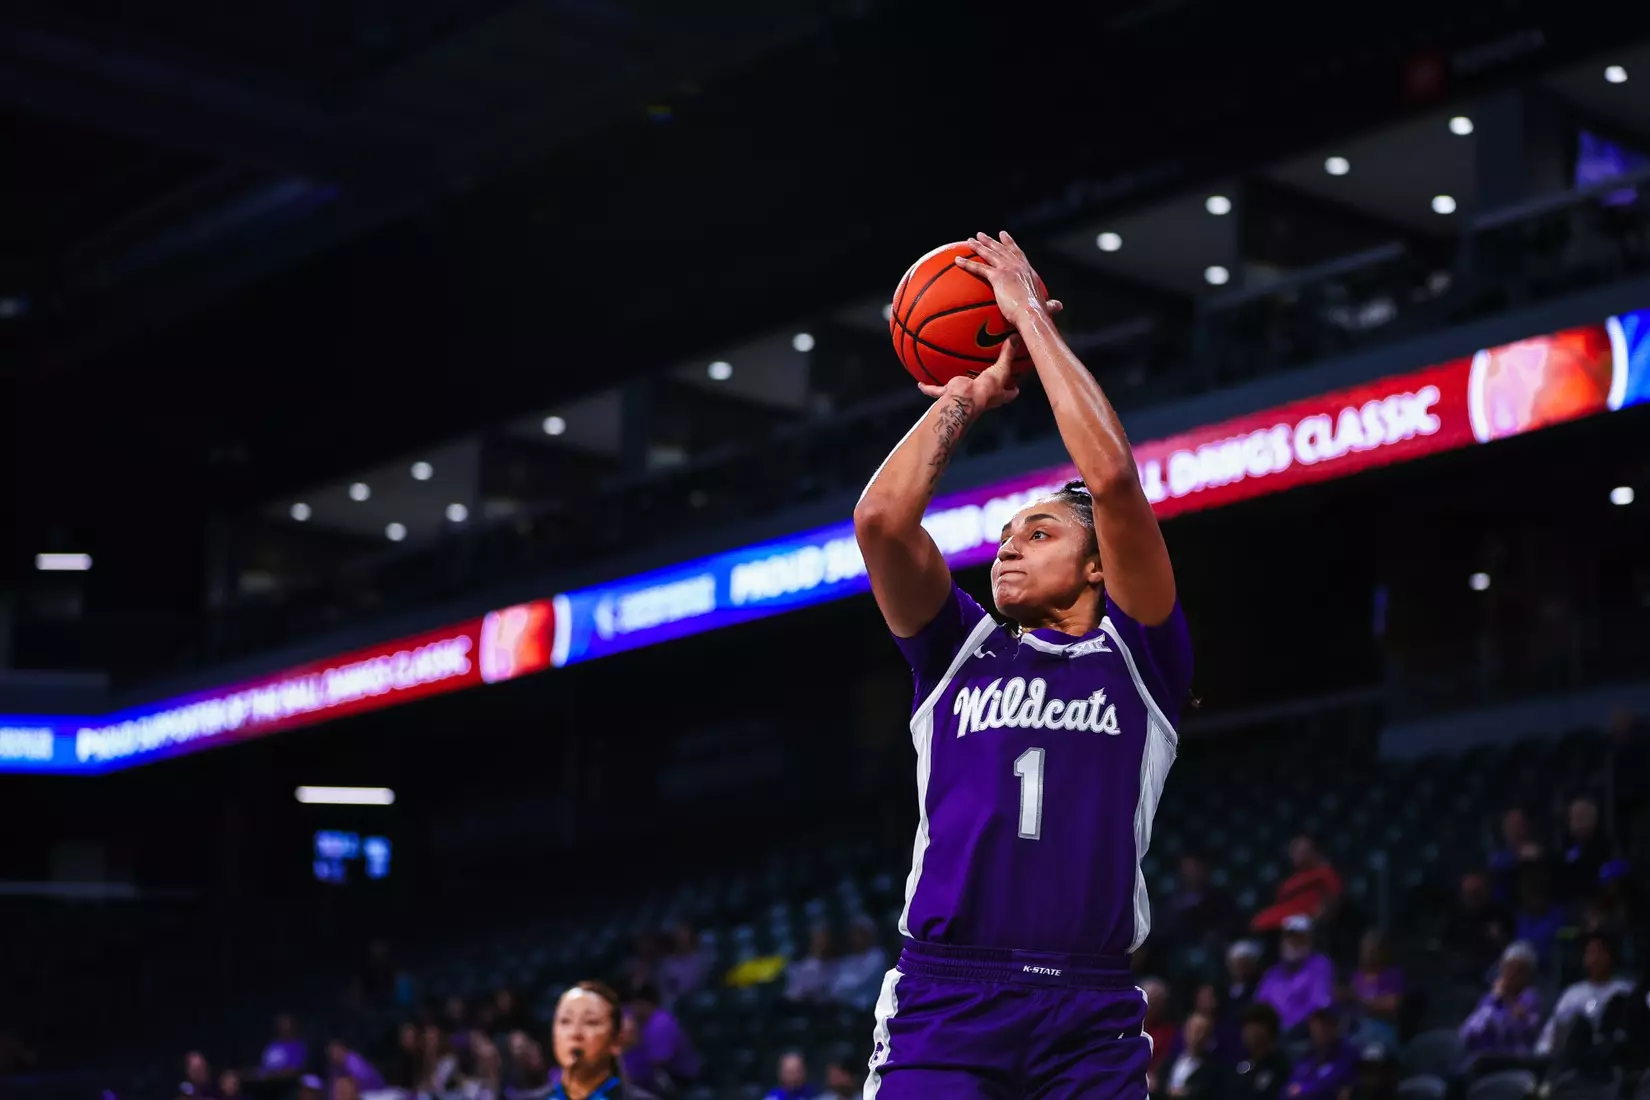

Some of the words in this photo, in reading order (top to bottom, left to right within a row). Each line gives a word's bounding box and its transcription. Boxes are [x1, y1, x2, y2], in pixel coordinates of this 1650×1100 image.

[1294, 385, 1441, 465] CLASSIC
[953, 676, 1121, 738] Wildcats
[1013, 746, 1045, 841] 1
[1022, 965, 1062, 977] K-STATE
